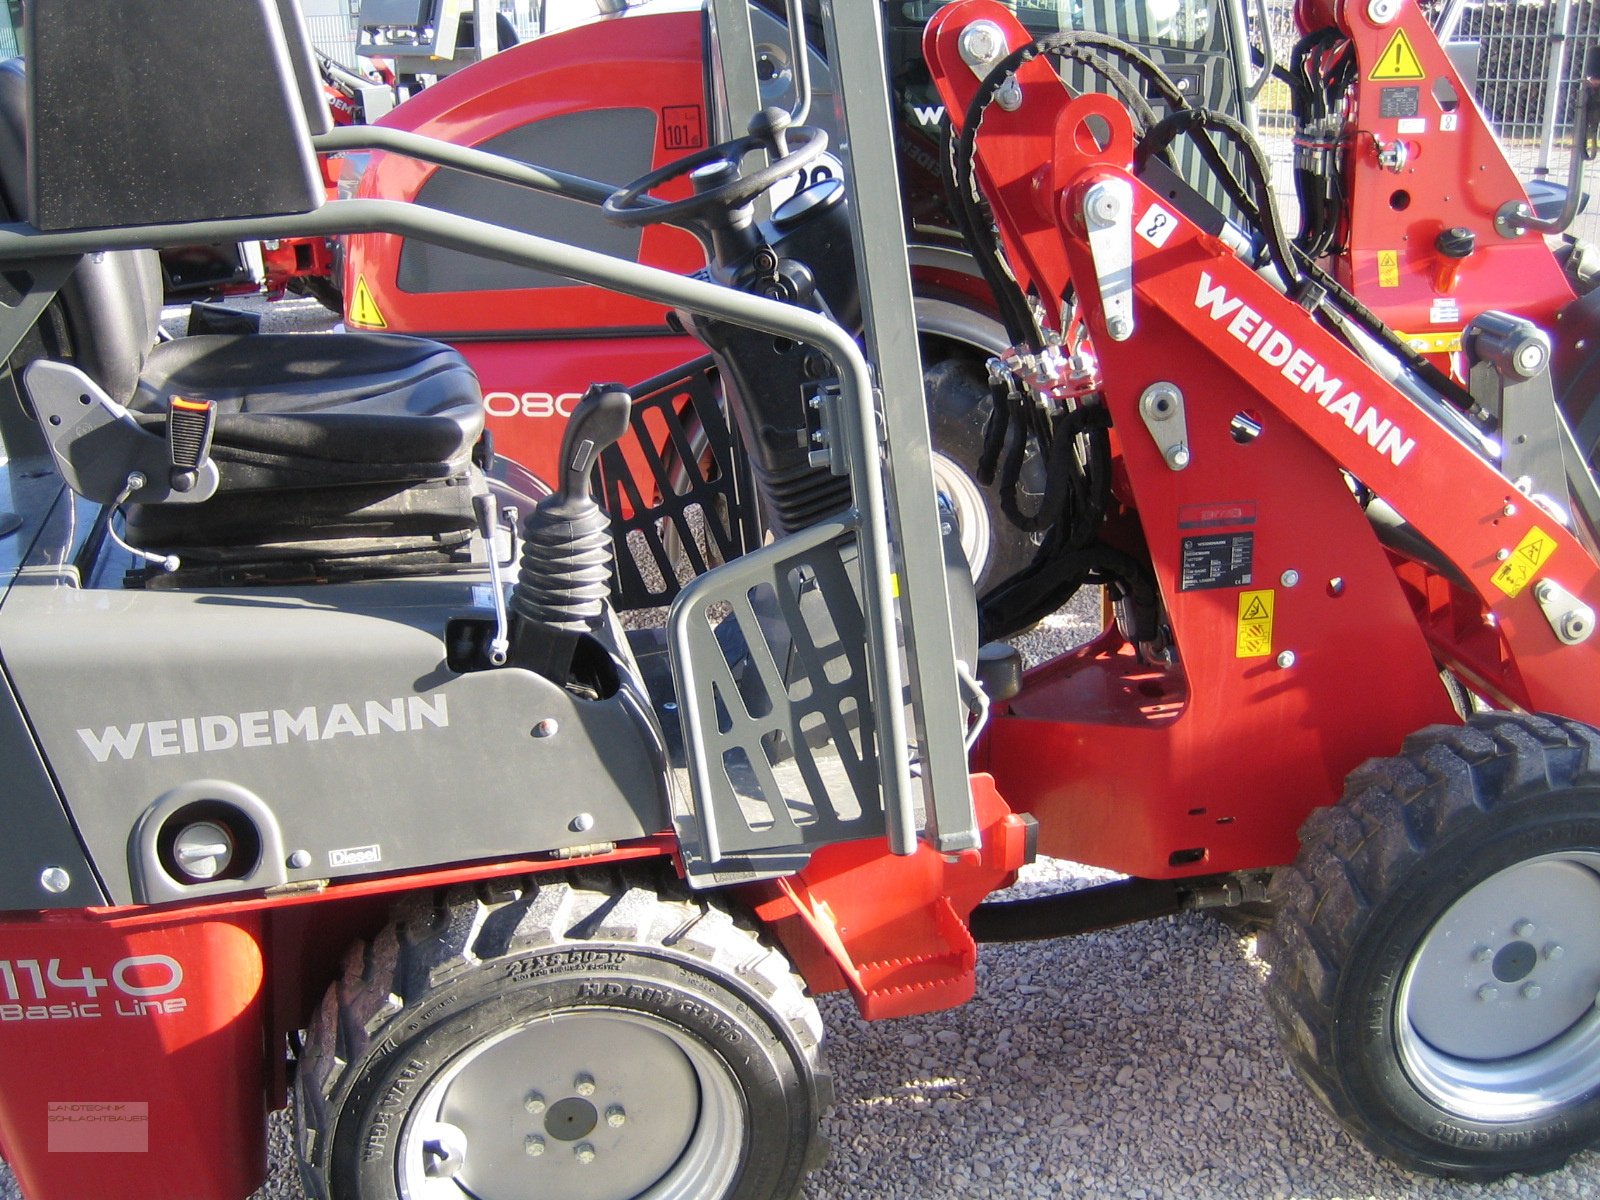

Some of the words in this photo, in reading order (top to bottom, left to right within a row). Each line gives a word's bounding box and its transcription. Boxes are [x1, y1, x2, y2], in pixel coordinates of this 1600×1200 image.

[667, 125, 689, 146] 101
[1194, 271, 1416, 467] WEIDEMANN
[76, 694, 449, 762] WEIDEMANN
[332, 847, 377, 865] Diesel
[0, 954, 183, 1000] 1140
[0, 1001, 102, 1021] Basic
[115, 997, 187, 1017] Line
